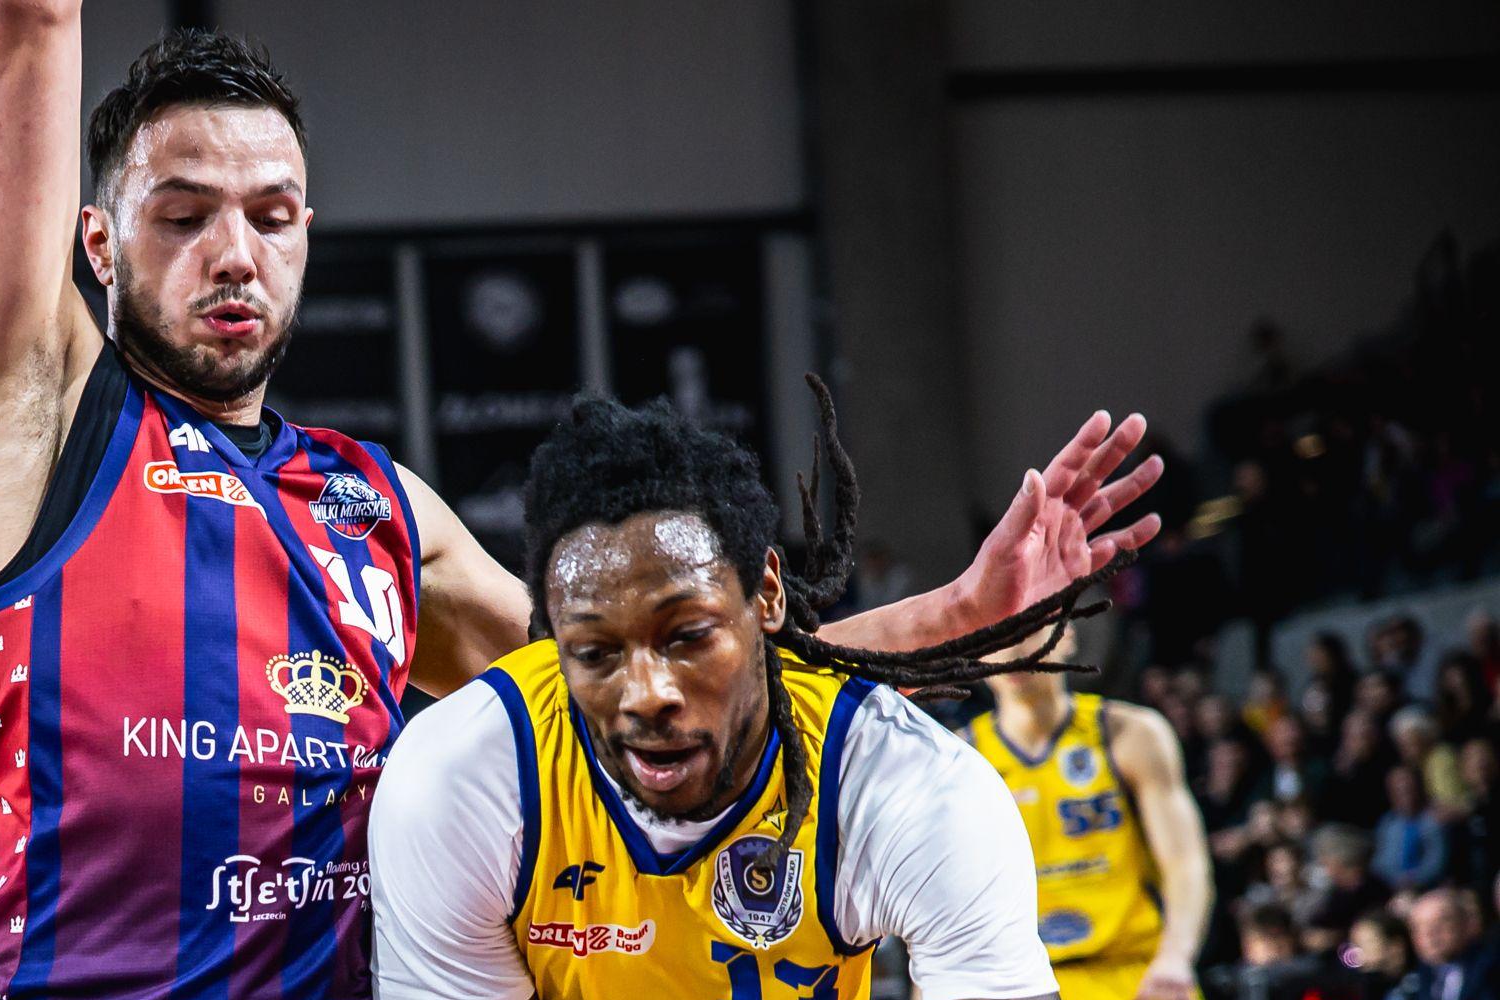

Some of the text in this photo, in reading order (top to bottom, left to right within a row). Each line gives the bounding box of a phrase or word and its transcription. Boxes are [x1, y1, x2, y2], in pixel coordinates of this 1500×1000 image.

[152, 468, 218, 492] OREN
[311, 499, 389, 520] WILKI MORSKIE
[308, 544, 406, 667] 10
[123, 716, 217, 761] KING
[1059, 793, 1122, 837] 55
[342, 872, 371, 900] 20
[552, 859, 606, 902] 4F
[747, 912, 772, 924] 1947
[616, 938, 642, 953] Liga
